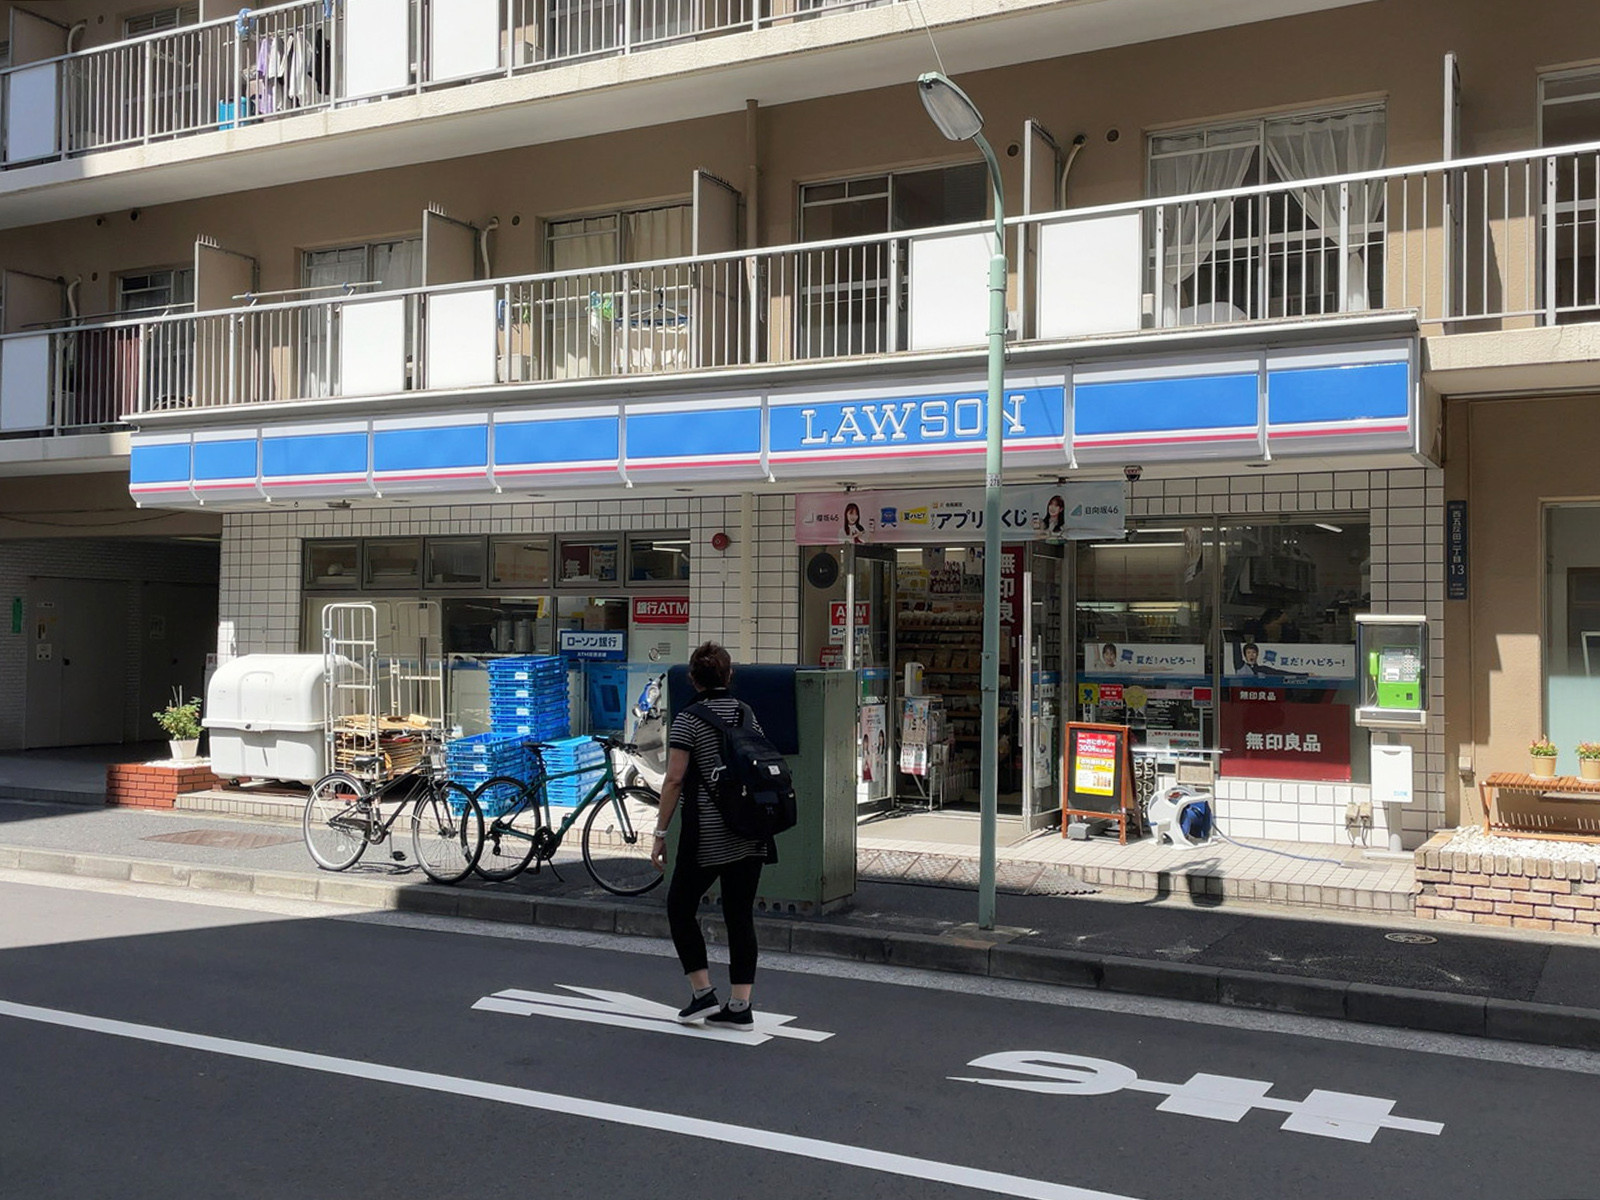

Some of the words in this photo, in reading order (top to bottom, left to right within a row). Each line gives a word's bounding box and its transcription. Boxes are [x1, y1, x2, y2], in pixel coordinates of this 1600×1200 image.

[801, 394, 1026, 446] LAWSON
[1085, 505, 1119, 516] 日向坂46
[936, 508, 1028, 531] アプリくじ
[1450, 565, 1465, 576] 13
[636, 601, 688, 615] 銀行ATM
[836, 605, 867, 617] AM
[567, 636, 617, 648] ローソン銀行
[1239, 690, 1277, 701] 無印良品
[1245, 731, 1322, 754] 無印良品
